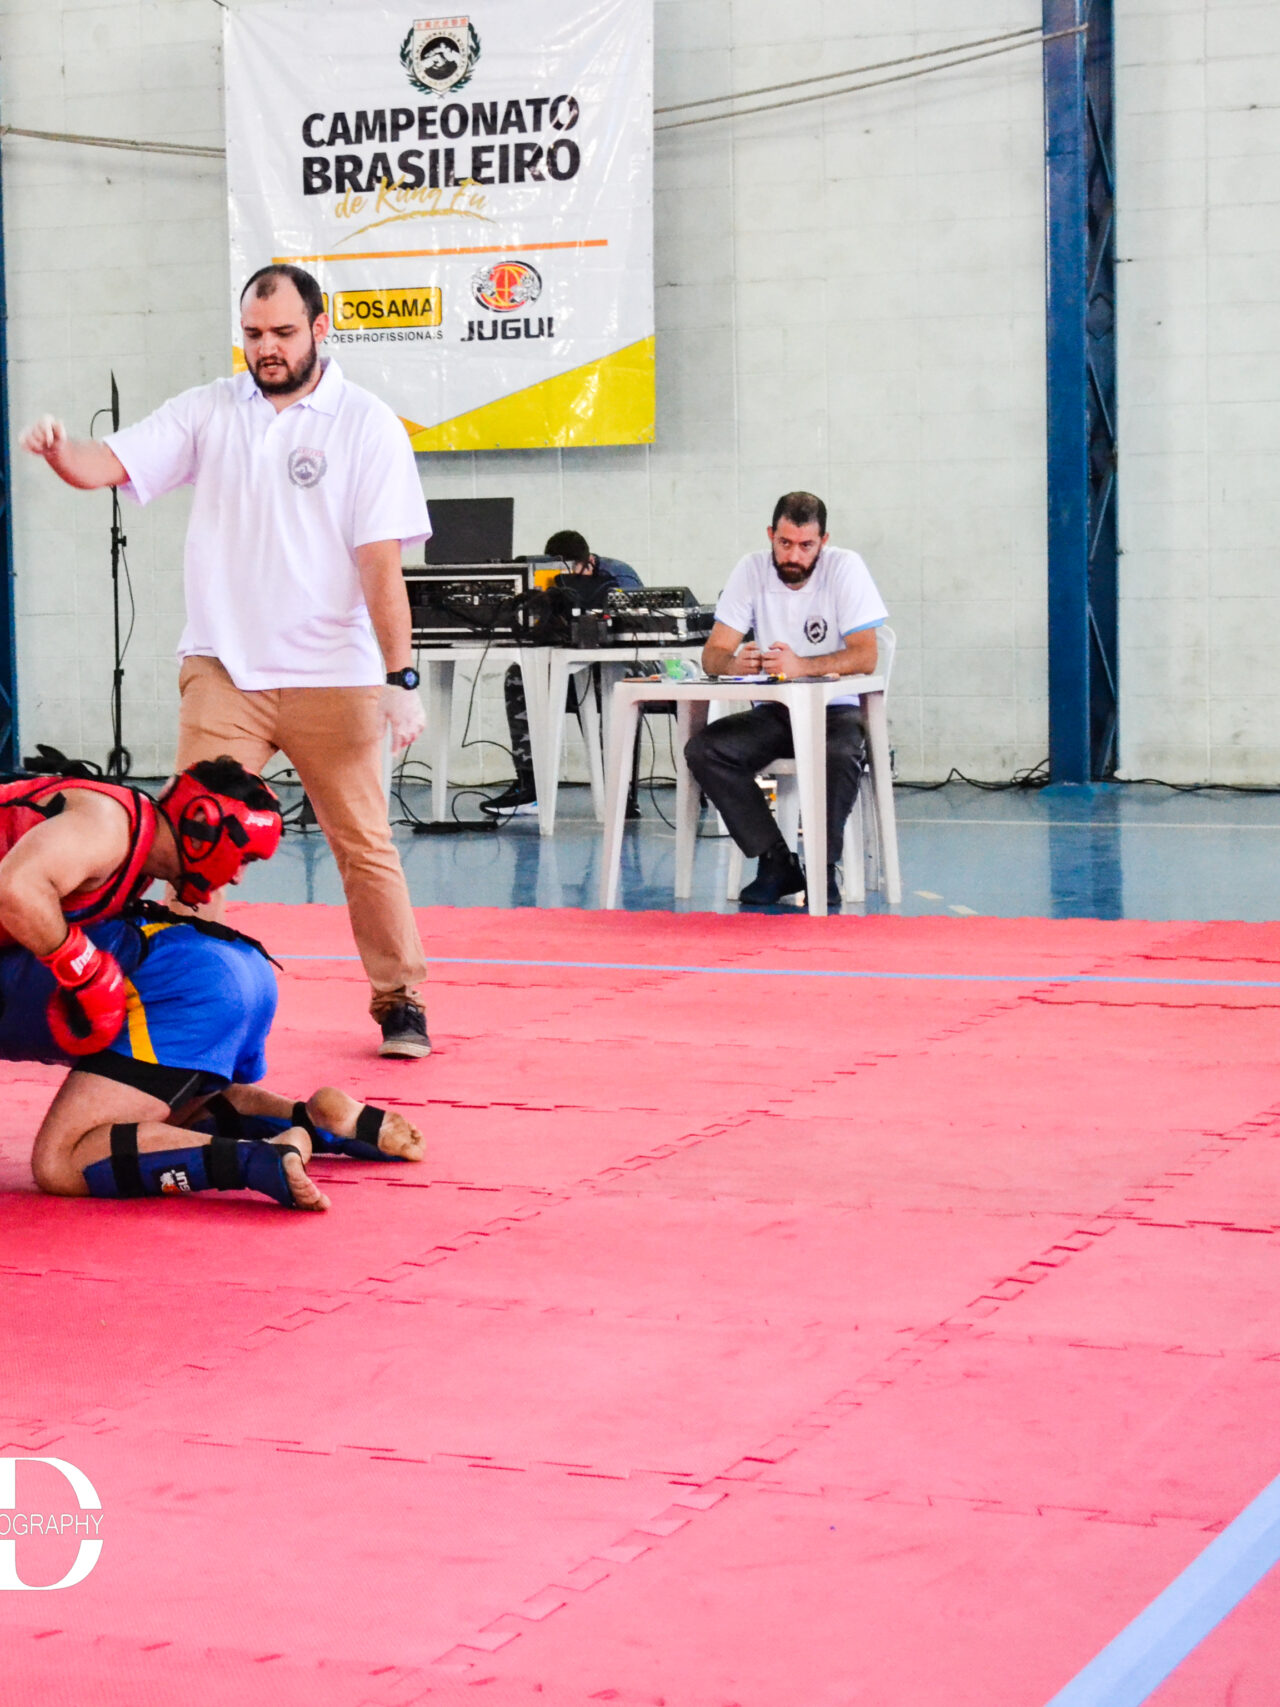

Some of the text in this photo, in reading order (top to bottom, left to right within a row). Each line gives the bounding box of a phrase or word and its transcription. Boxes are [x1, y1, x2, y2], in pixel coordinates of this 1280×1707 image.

[302, 95, 580, 148] CAMPEONATO
[303, 138, 580, 195] BRASILEIRO
[334, 187, 368, 218] de
[375, 174, 443, 213] Kung
[341, 298, 433, 320] COSAMA
[355, 330, 444, 343] PROFISSIONAS
[460, 316, 555, 342] JUGUI
